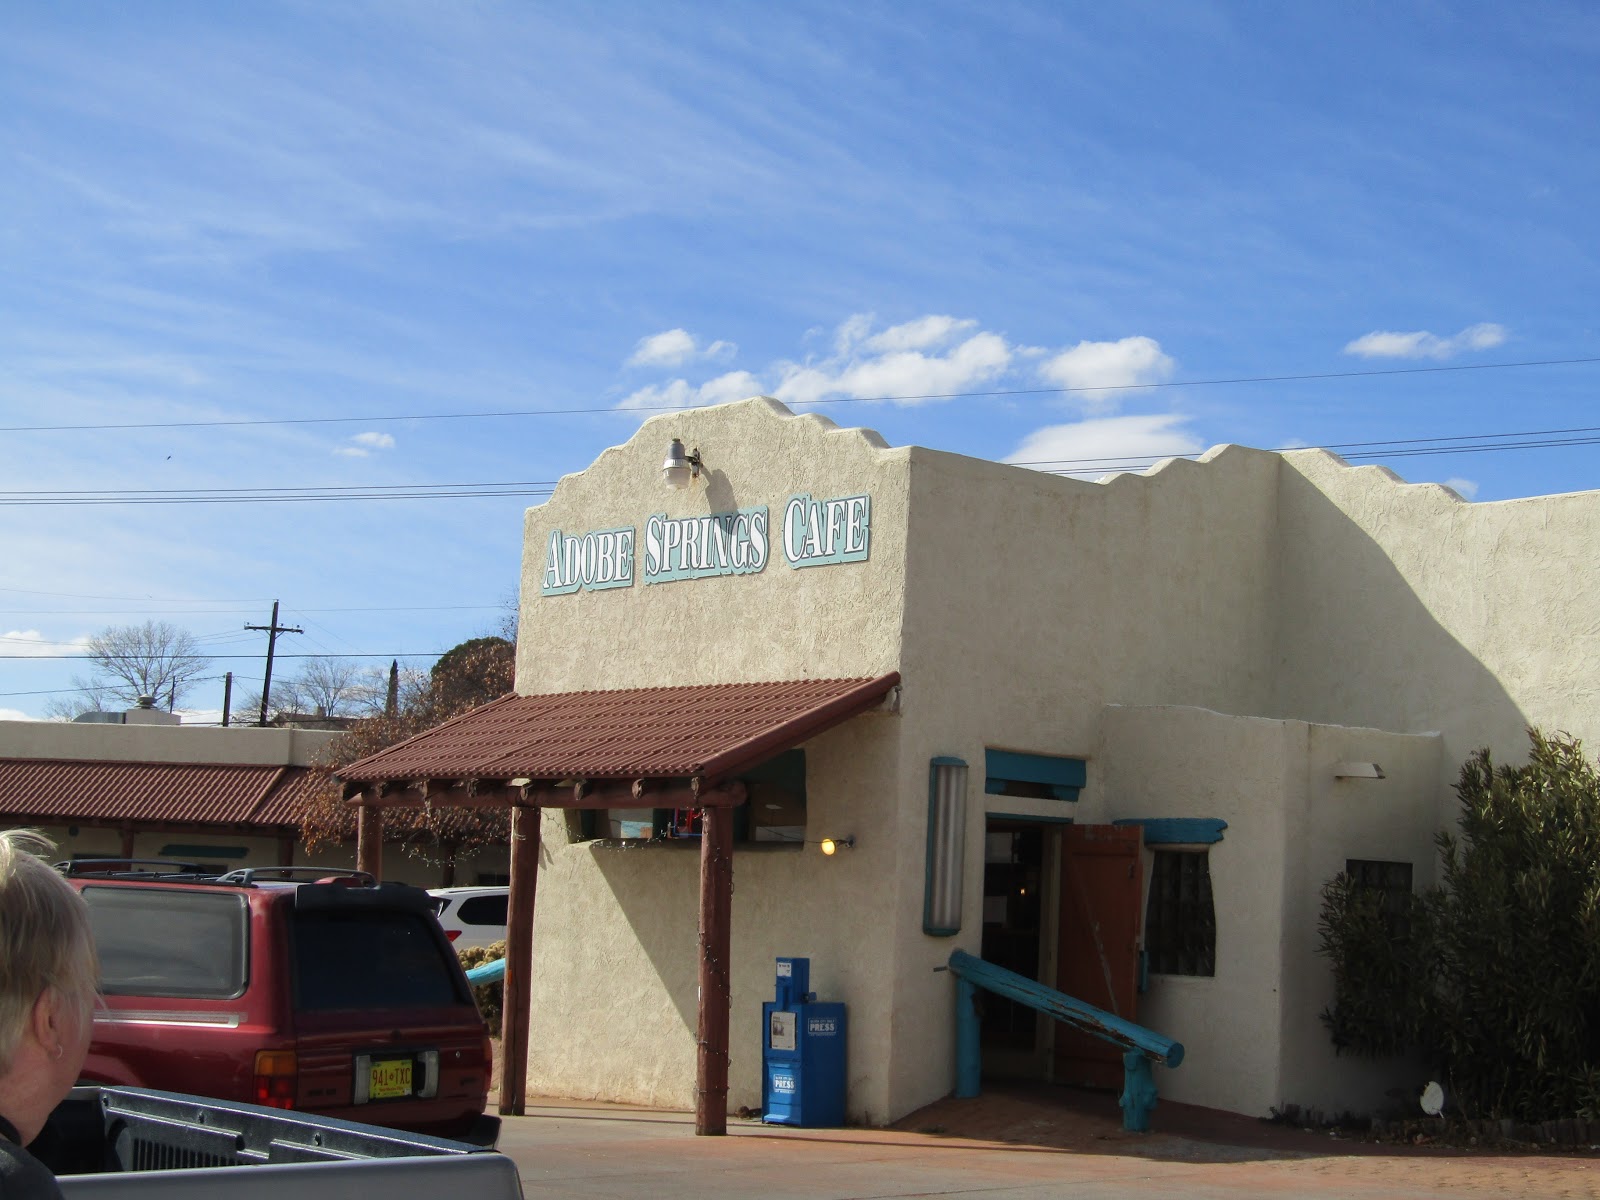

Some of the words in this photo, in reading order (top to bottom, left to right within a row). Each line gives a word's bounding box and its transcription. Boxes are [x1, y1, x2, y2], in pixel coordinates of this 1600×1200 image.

[542, 529, 635, 589] ADOBE
[645, 510, 769, 577] SPRINGS
[782, 494, 869, 564] CAFE
[809, 1023, 835, 1032] PRESS
[775, 1080, 795, 1089] PRESS
